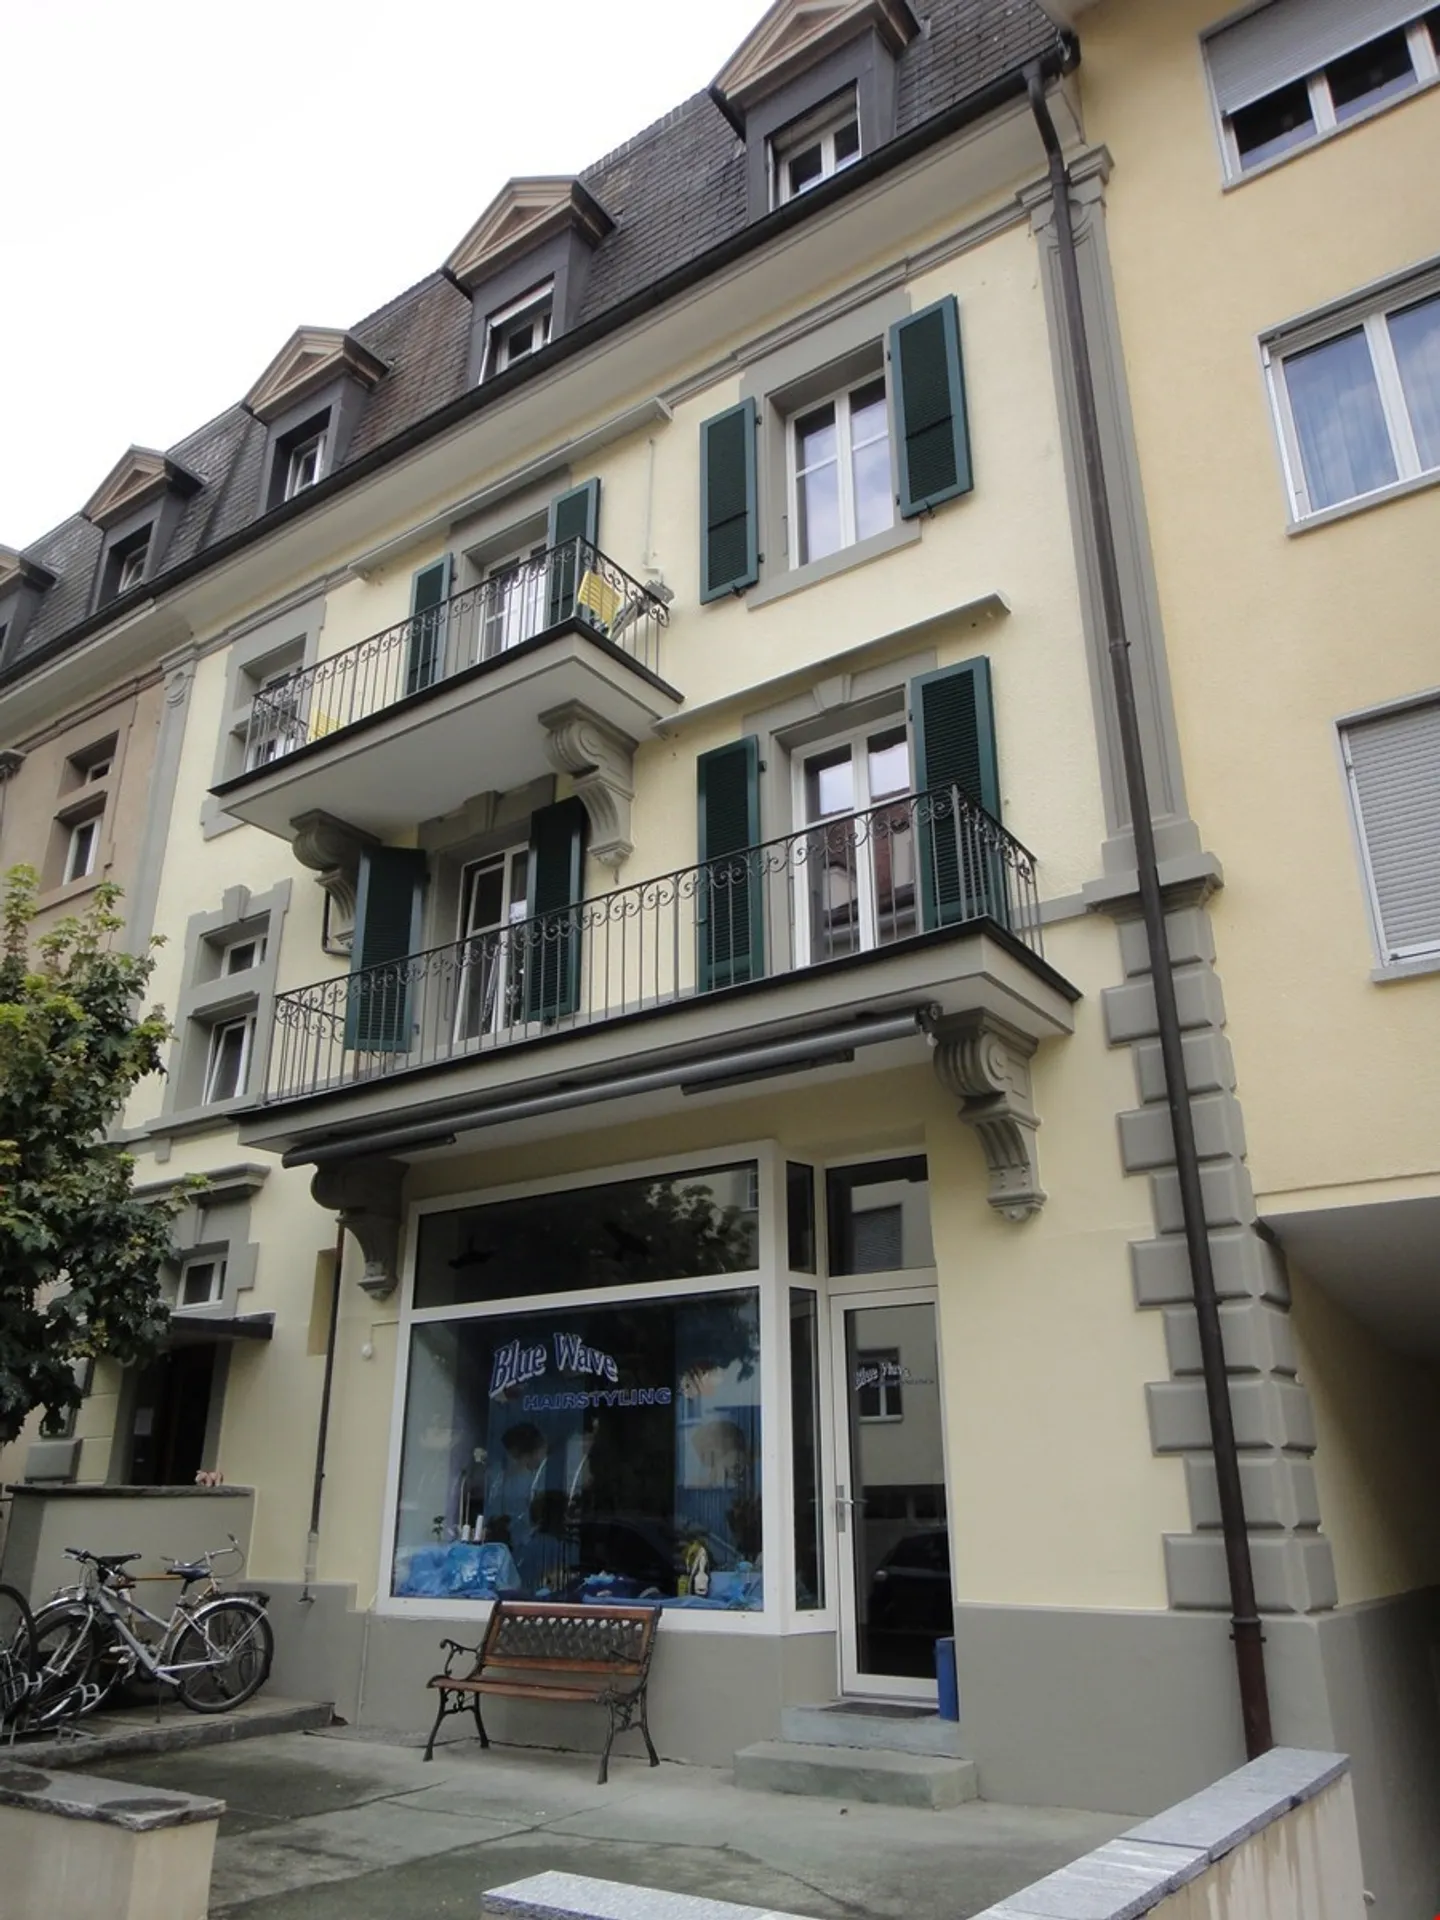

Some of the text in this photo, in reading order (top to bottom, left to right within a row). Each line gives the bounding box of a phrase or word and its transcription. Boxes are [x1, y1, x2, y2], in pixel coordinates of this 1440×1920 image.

[489, 1333, 619, 1398] Blue Wave
[523, 1387, 672, 1410] HAIRSTYLING
